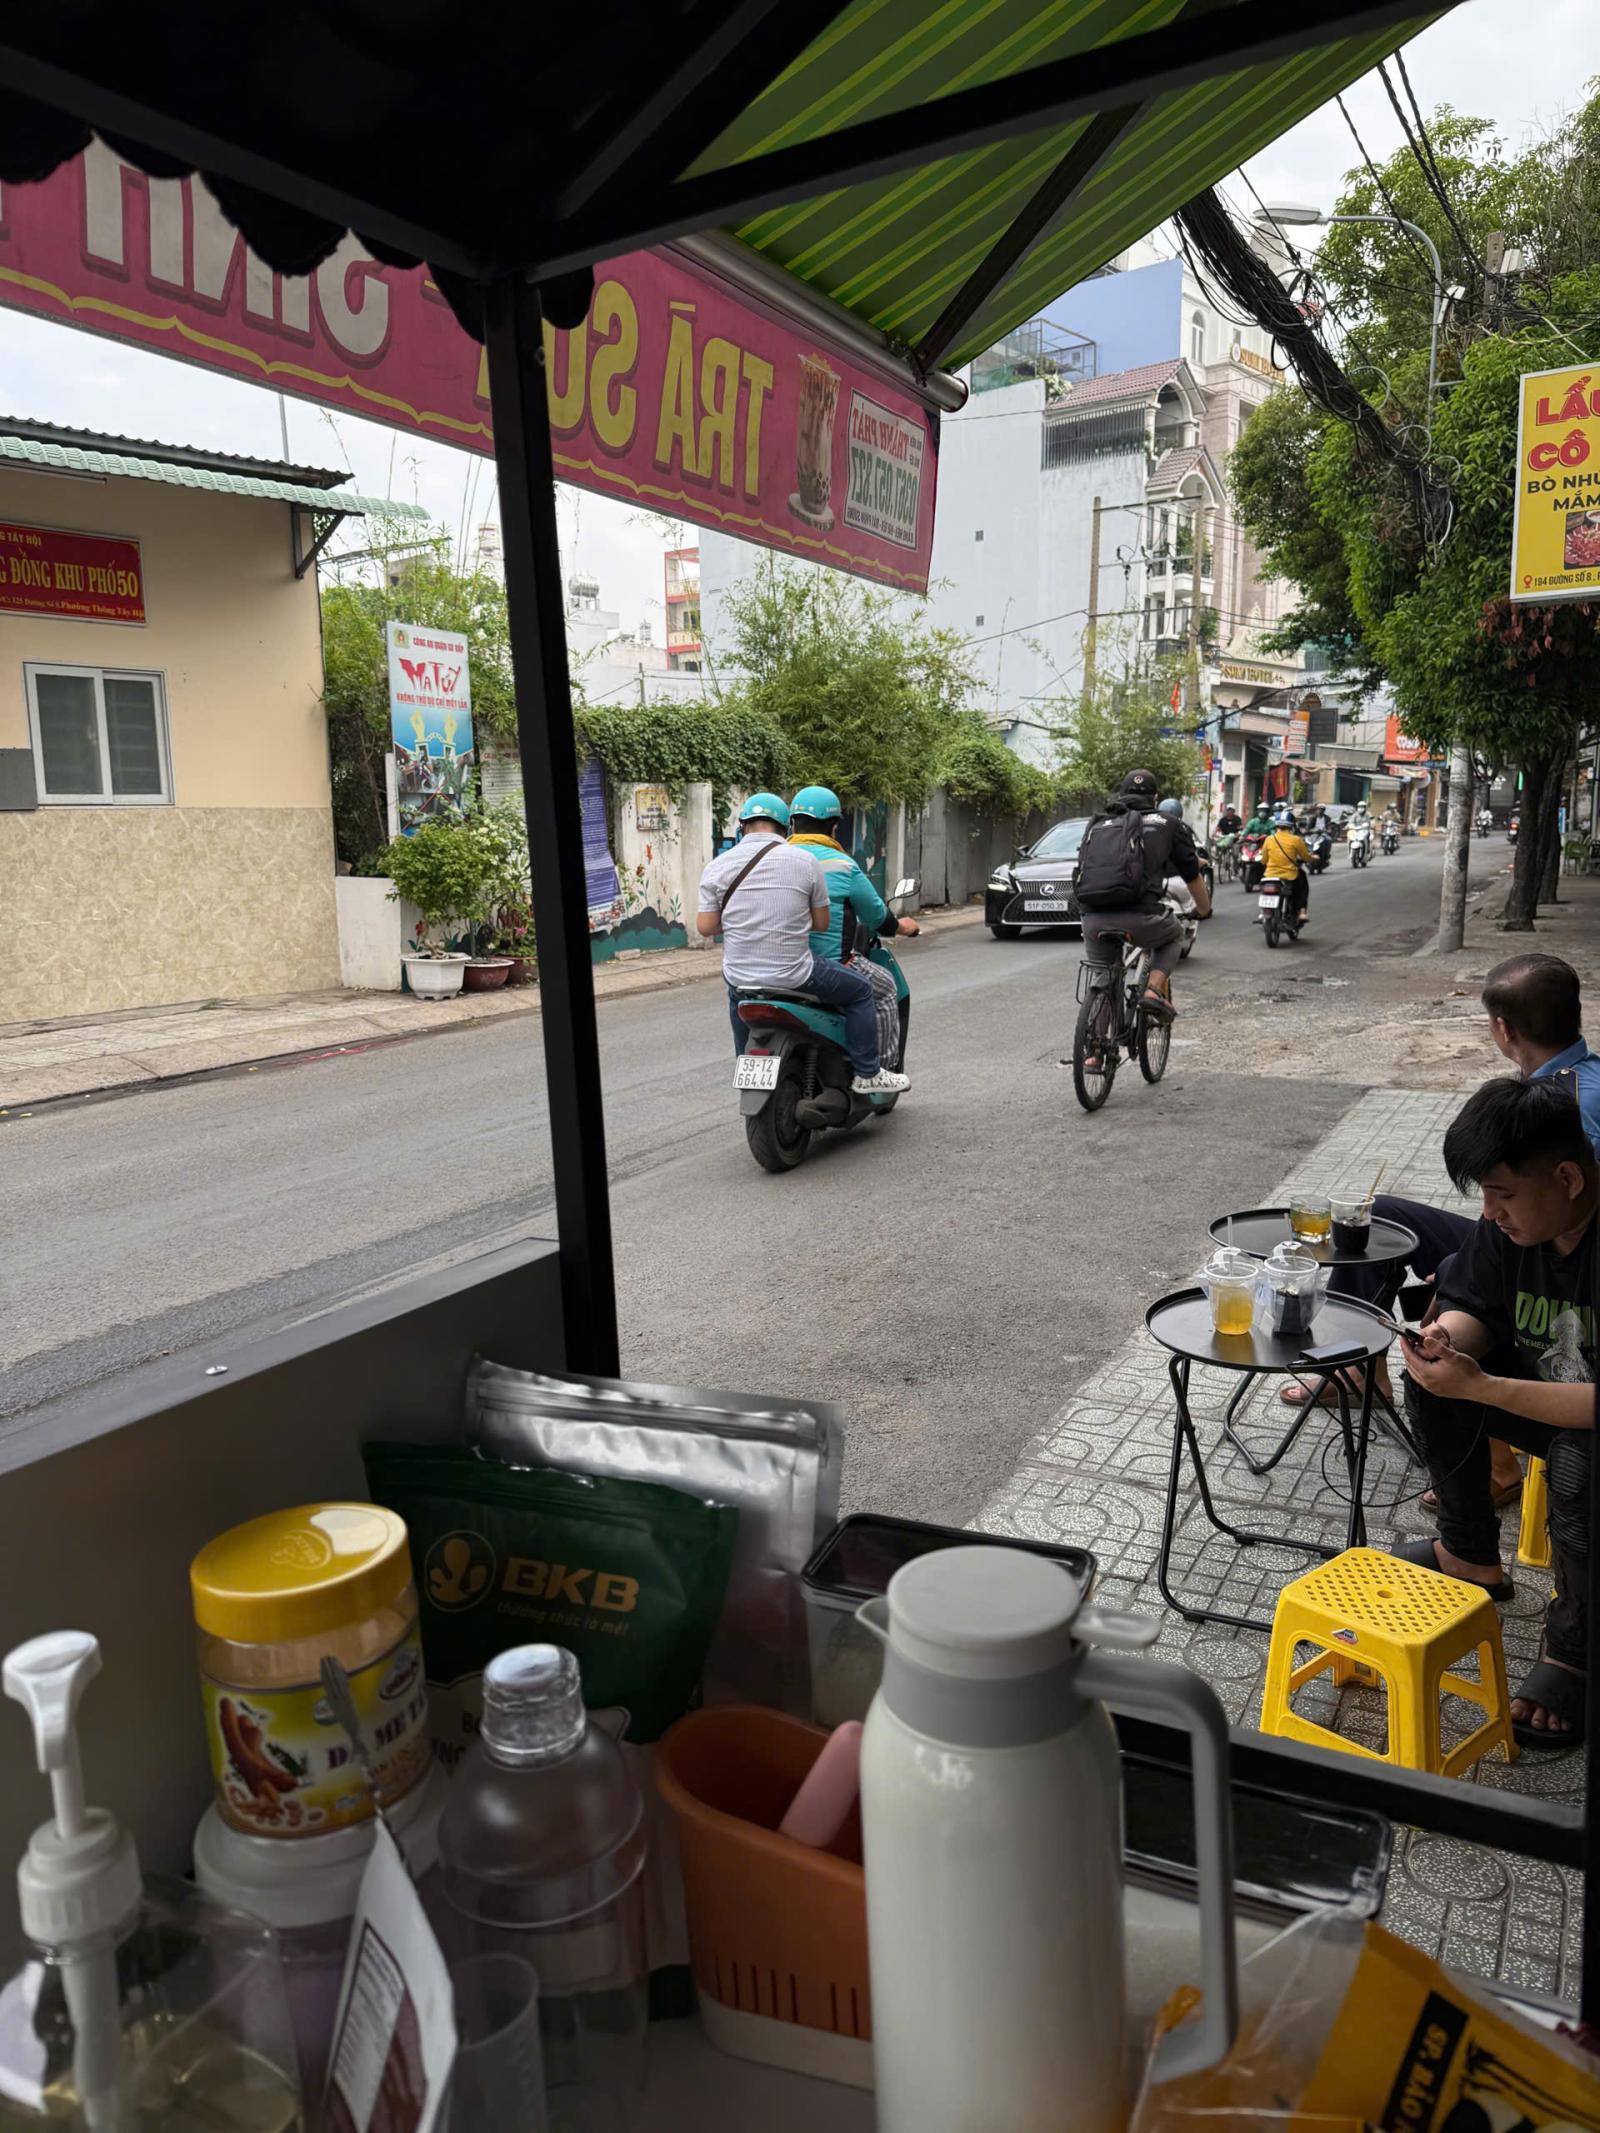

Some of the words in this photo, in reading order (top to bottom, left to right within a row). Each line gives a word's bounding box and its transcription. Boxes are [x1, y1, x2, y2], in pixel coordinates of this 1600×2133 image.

[1528, 429, 1591, 471] CÔ
[1528, 476, 1557, 494] BÒ
[1553, 490, 1600, 511] MẮM
[7, 531, 24, 543] TÂY
[26, 536, 42, 547] HỘI
[10, 546, 52, 588] ĐỒNG
[54, 562, 84, 591] KHU
[1534, 576, 1548, 586] 194
[1575, 569, 1587, 583] SỐ
[737, 1073, 773, 1087] 664.44
[502, 1556, 640, 1613] BKB
